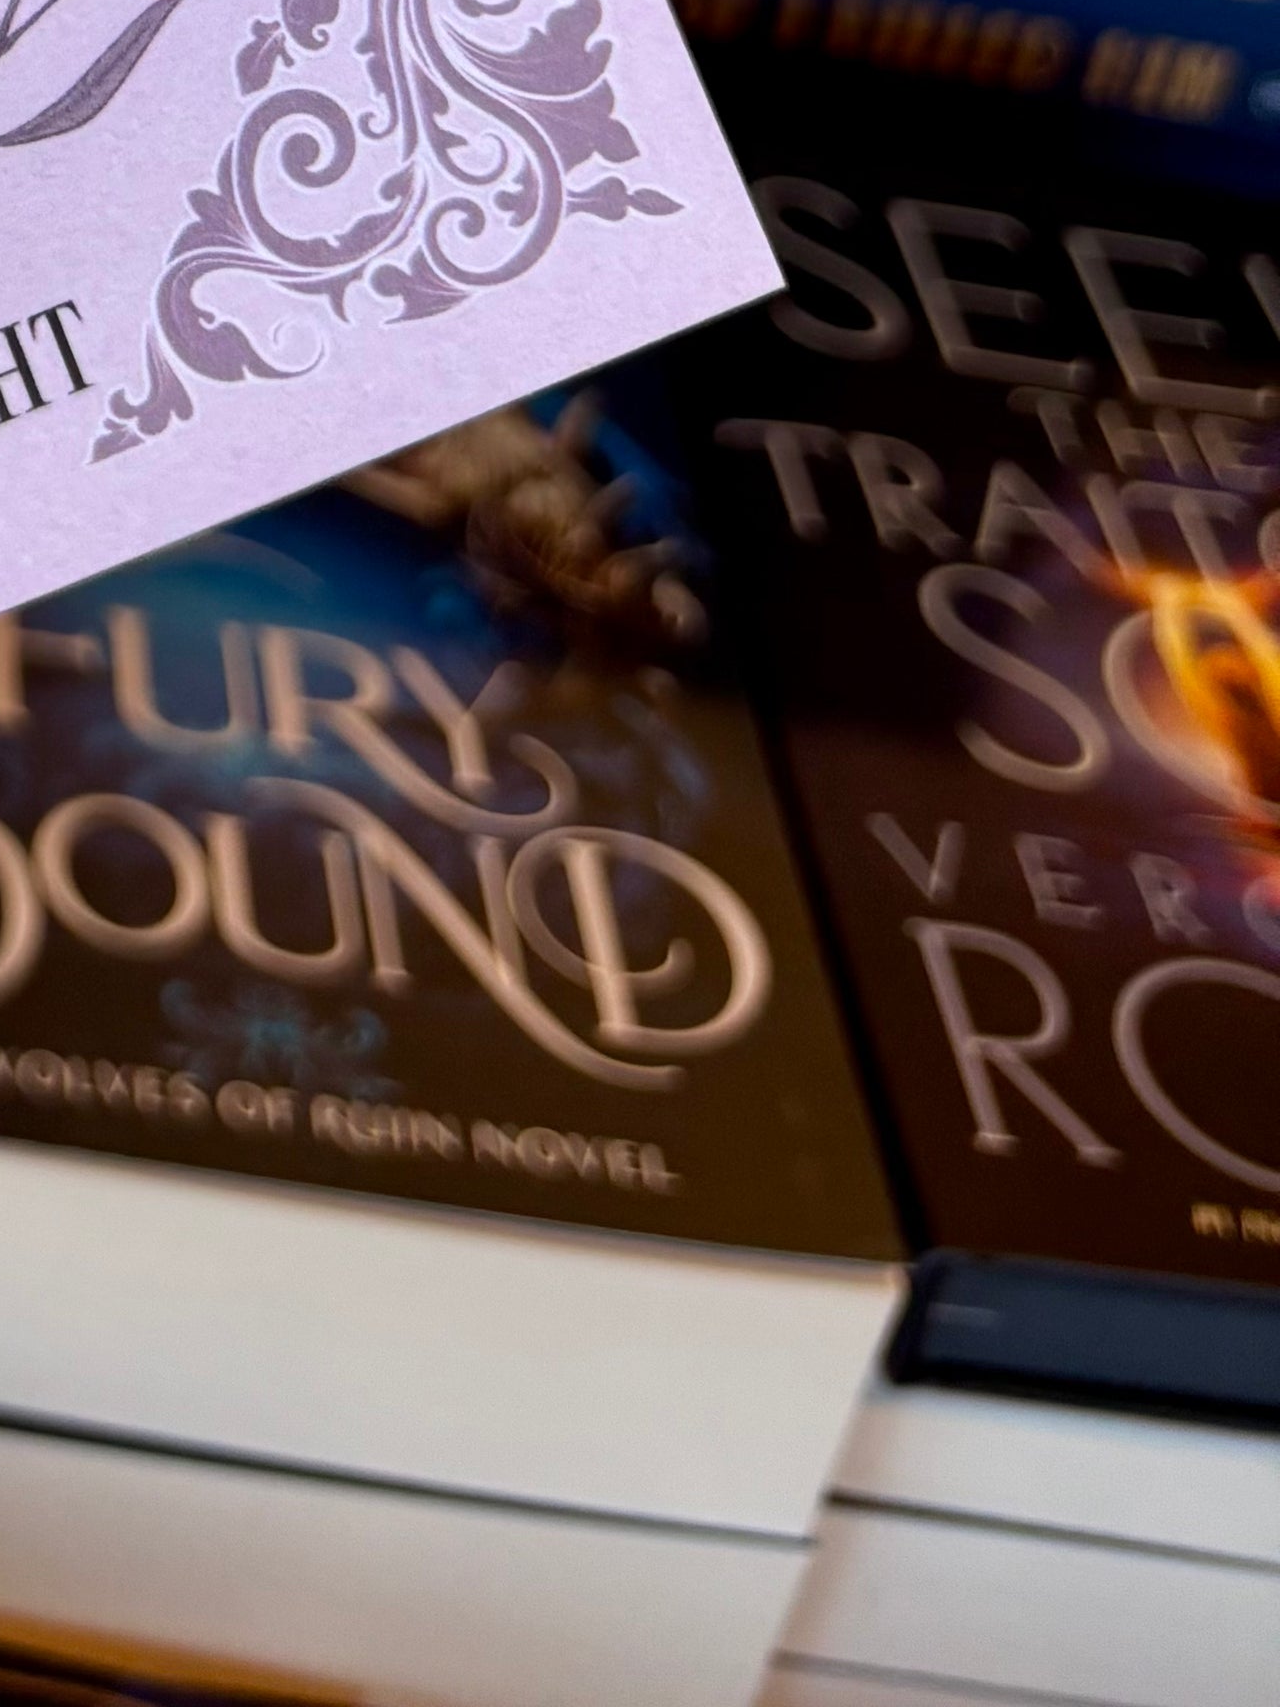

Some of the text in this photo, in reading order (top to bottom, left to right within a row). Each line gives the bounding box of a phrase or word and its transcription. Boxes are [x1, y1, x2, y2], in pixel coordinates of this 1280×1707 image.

[214, 1077, 302, 1137] OF
[307, 1091, 466, 1165] RUIN
[469, 1117, 684, 1199] NOVEL
